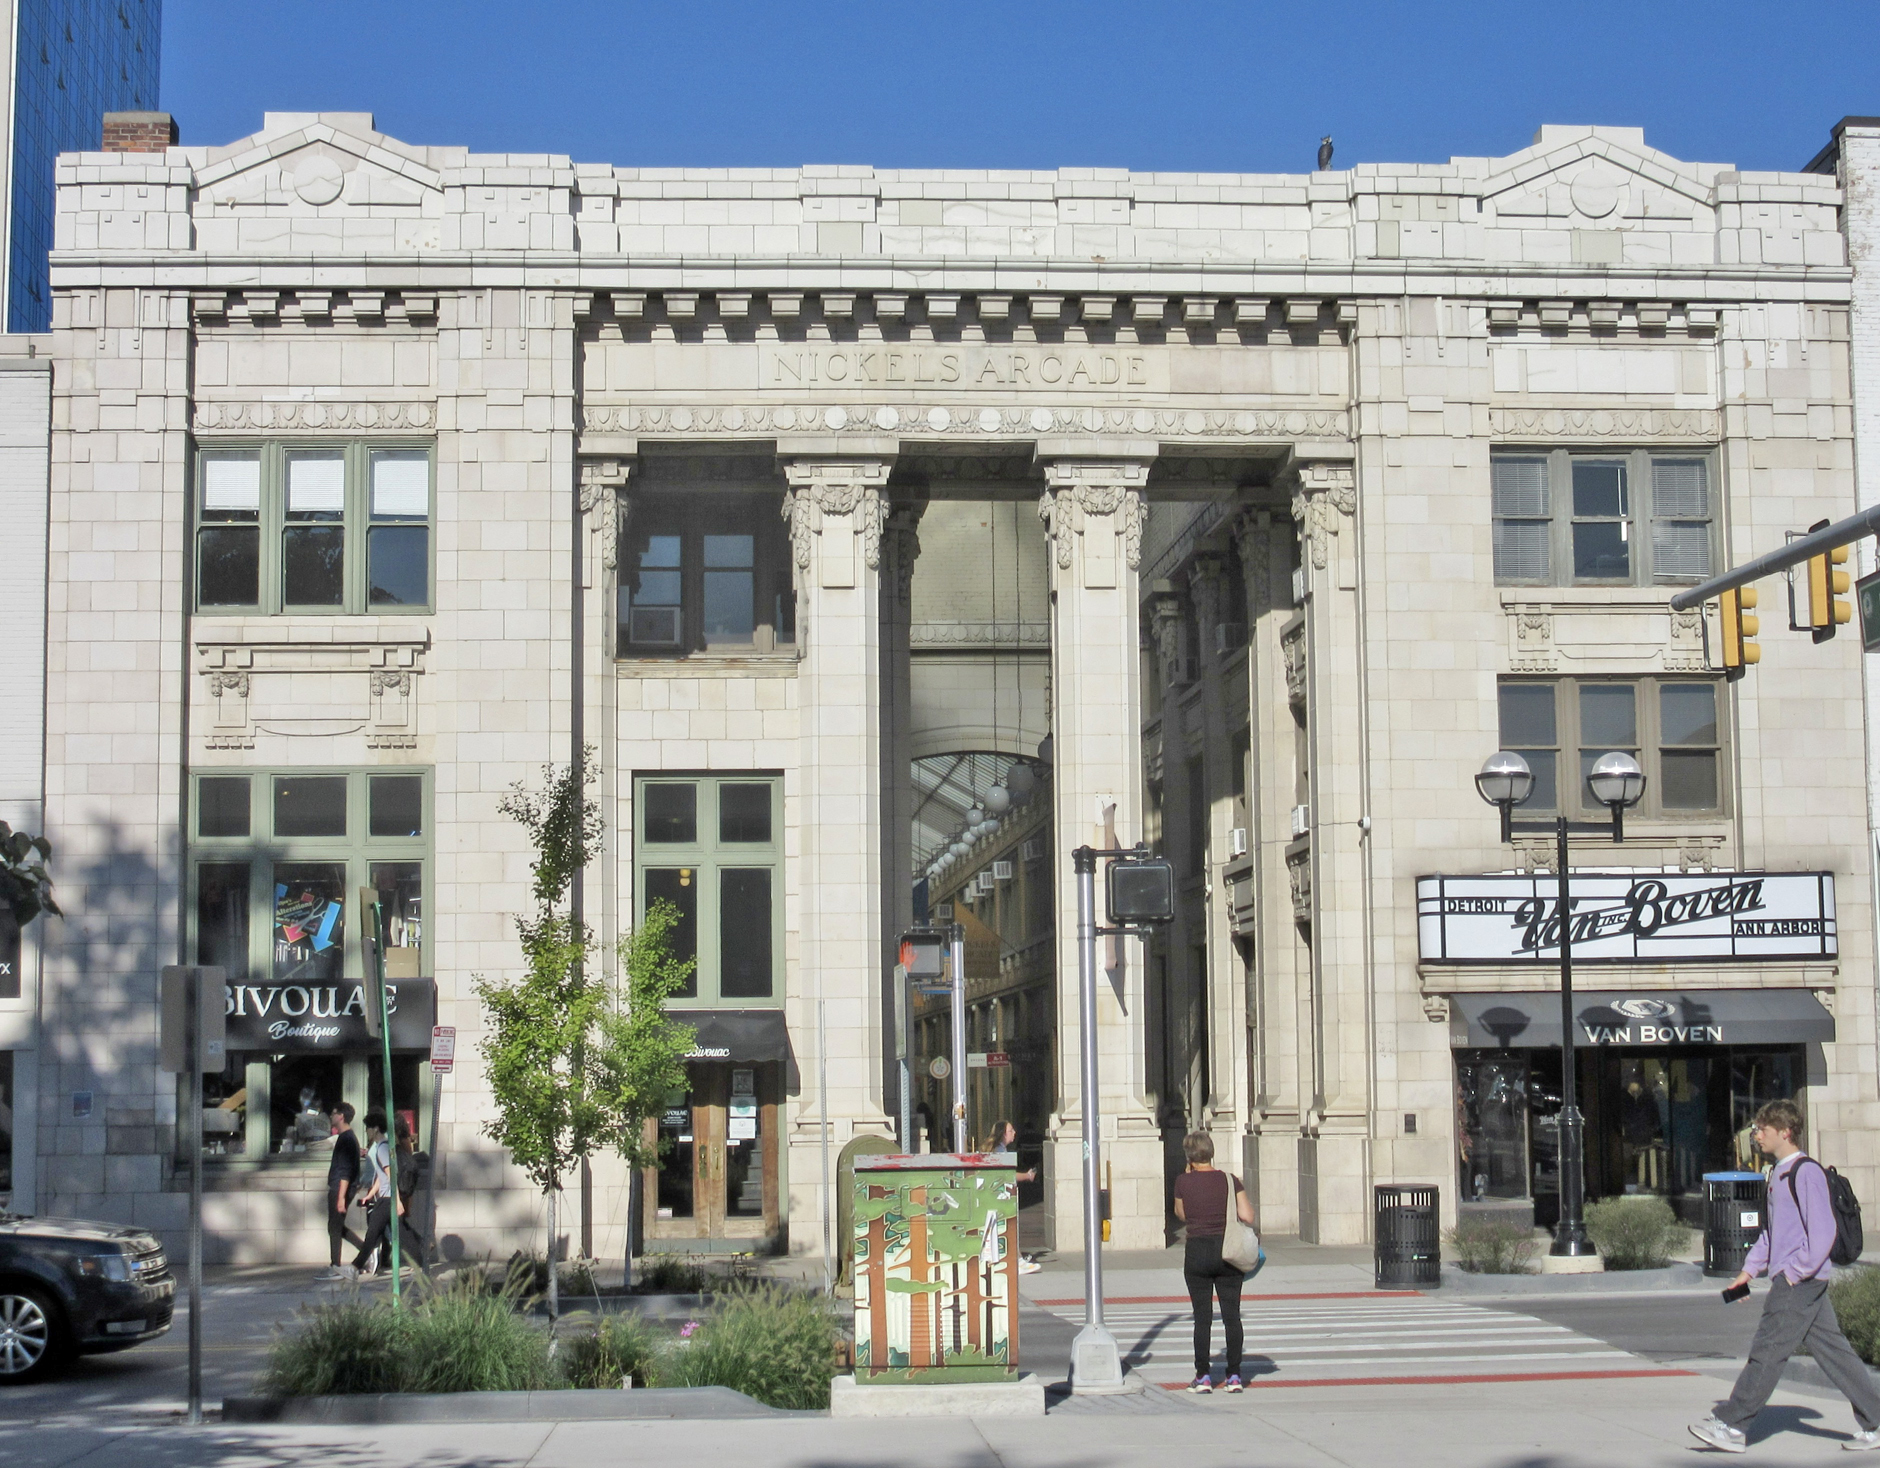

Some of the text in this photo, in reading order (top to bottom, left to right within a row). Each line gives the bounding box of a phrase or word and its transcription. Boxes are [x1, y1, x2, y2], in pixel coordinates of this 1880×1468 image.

[774, 353, 1147, 385] NICKELS ARCADE
[1448, 900, 1507, 912] DETROIT
[1512, 898, 1602, 952] Van
[1620, 880, 1765, 937] Boven
[1735, 921, 1821, 935] ANN ARBOR
[268, 1020, 341, 1043] Boutique
[1584, 1025, 1723, 1043] VAN BOVEN
